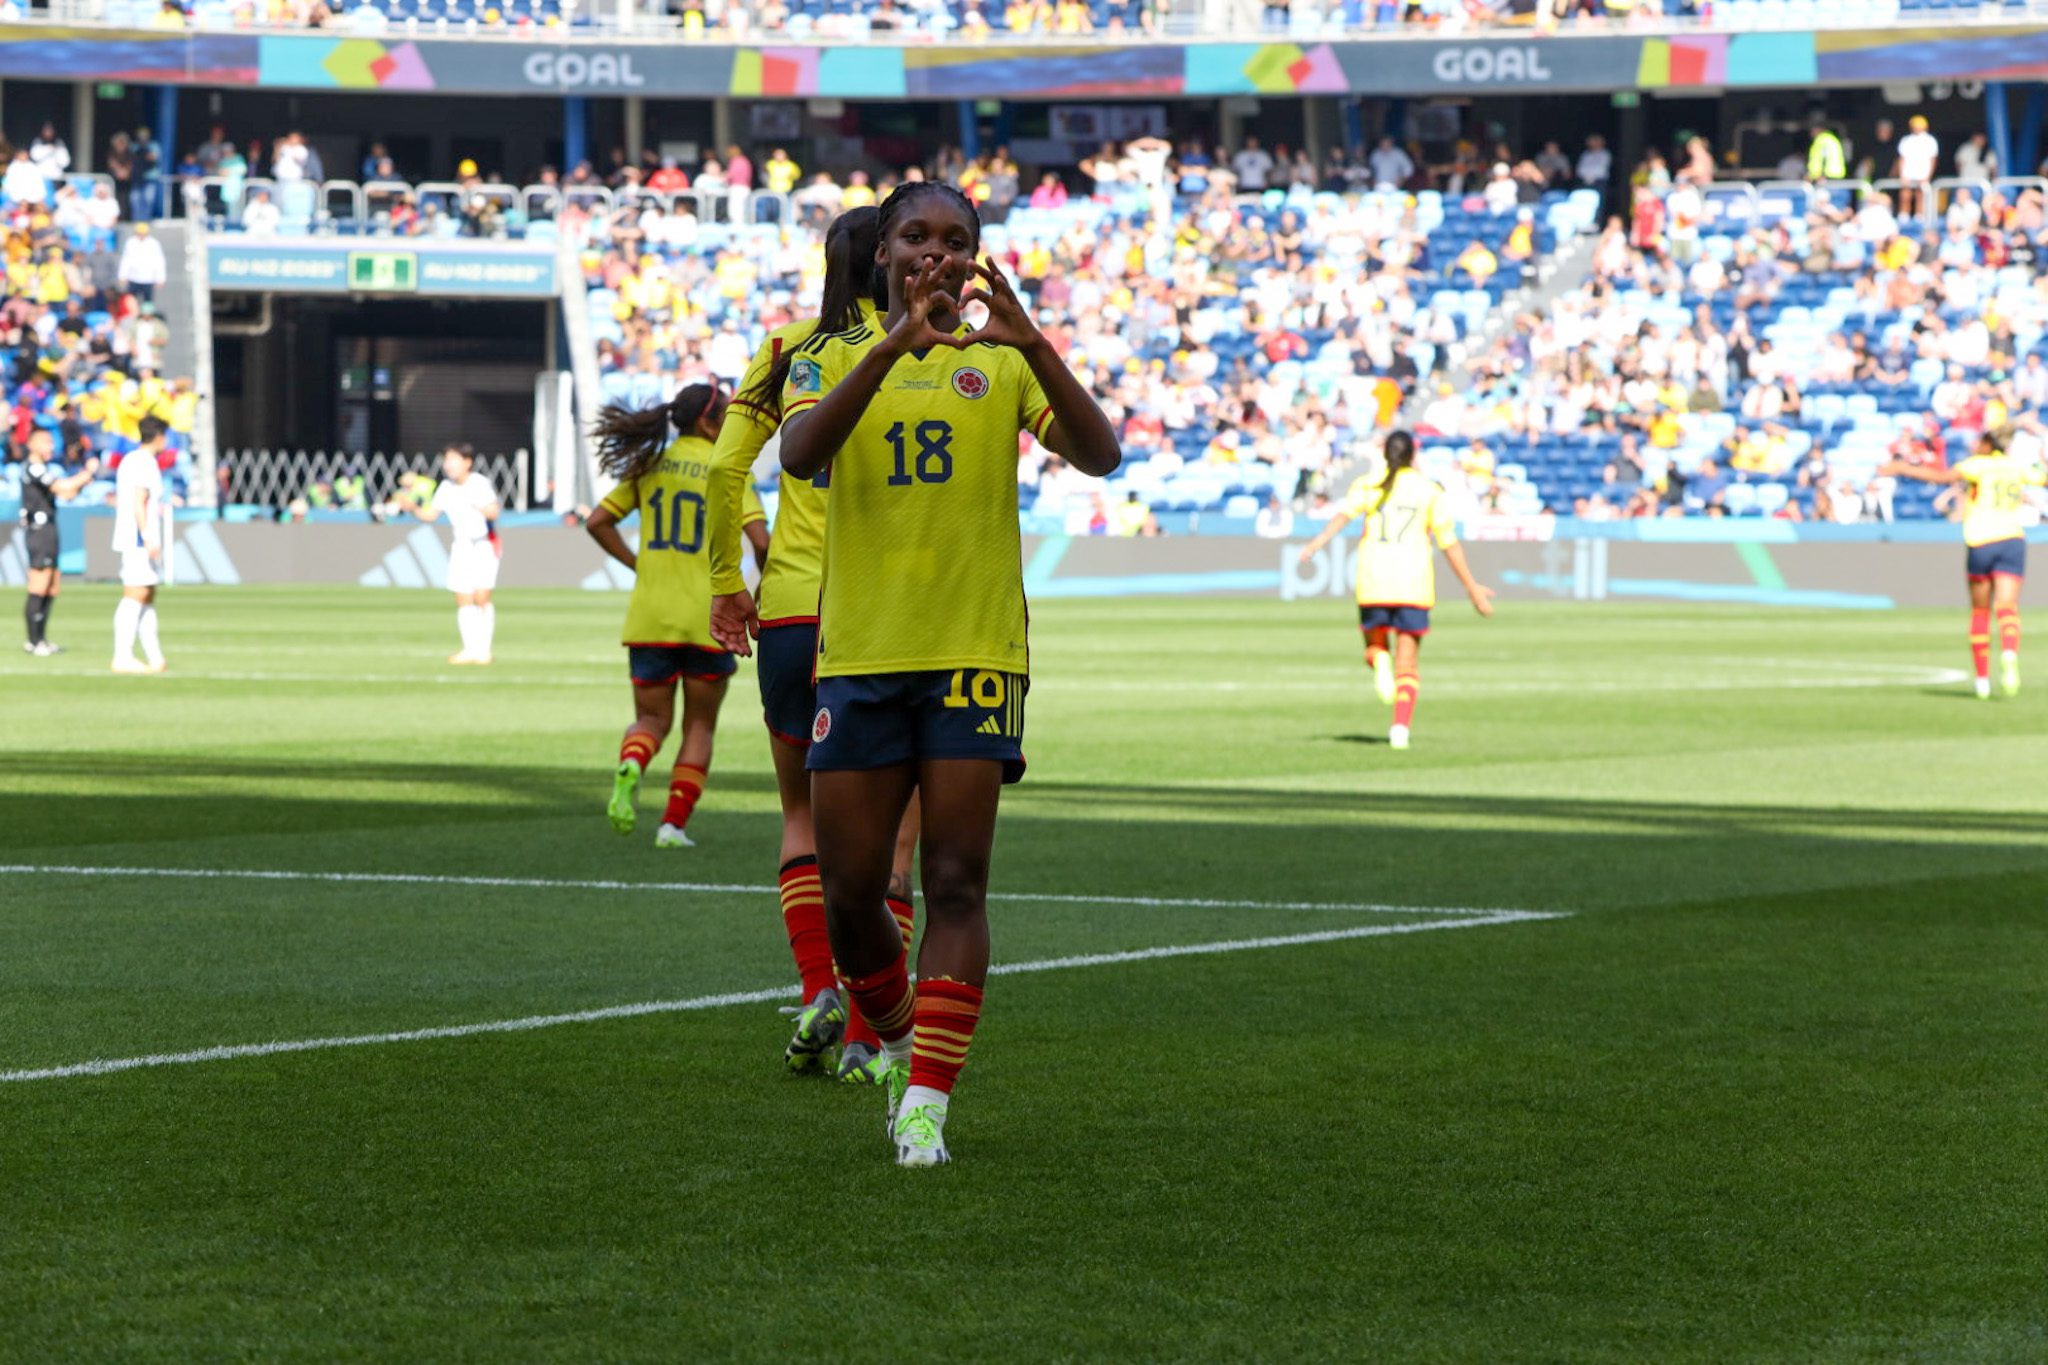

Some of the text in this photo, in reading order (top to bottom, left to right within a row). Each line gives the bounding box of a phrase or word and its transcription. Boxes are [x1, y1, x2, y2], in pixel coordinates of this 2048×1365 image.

[524, 52, 645, 86] GOAL
[1432, 46, 1551, 82] GOAL
[884, 420, 953, 486] 18
[647, 488, 706, 555] 10
[1377, 505, 1417, 543] 17
